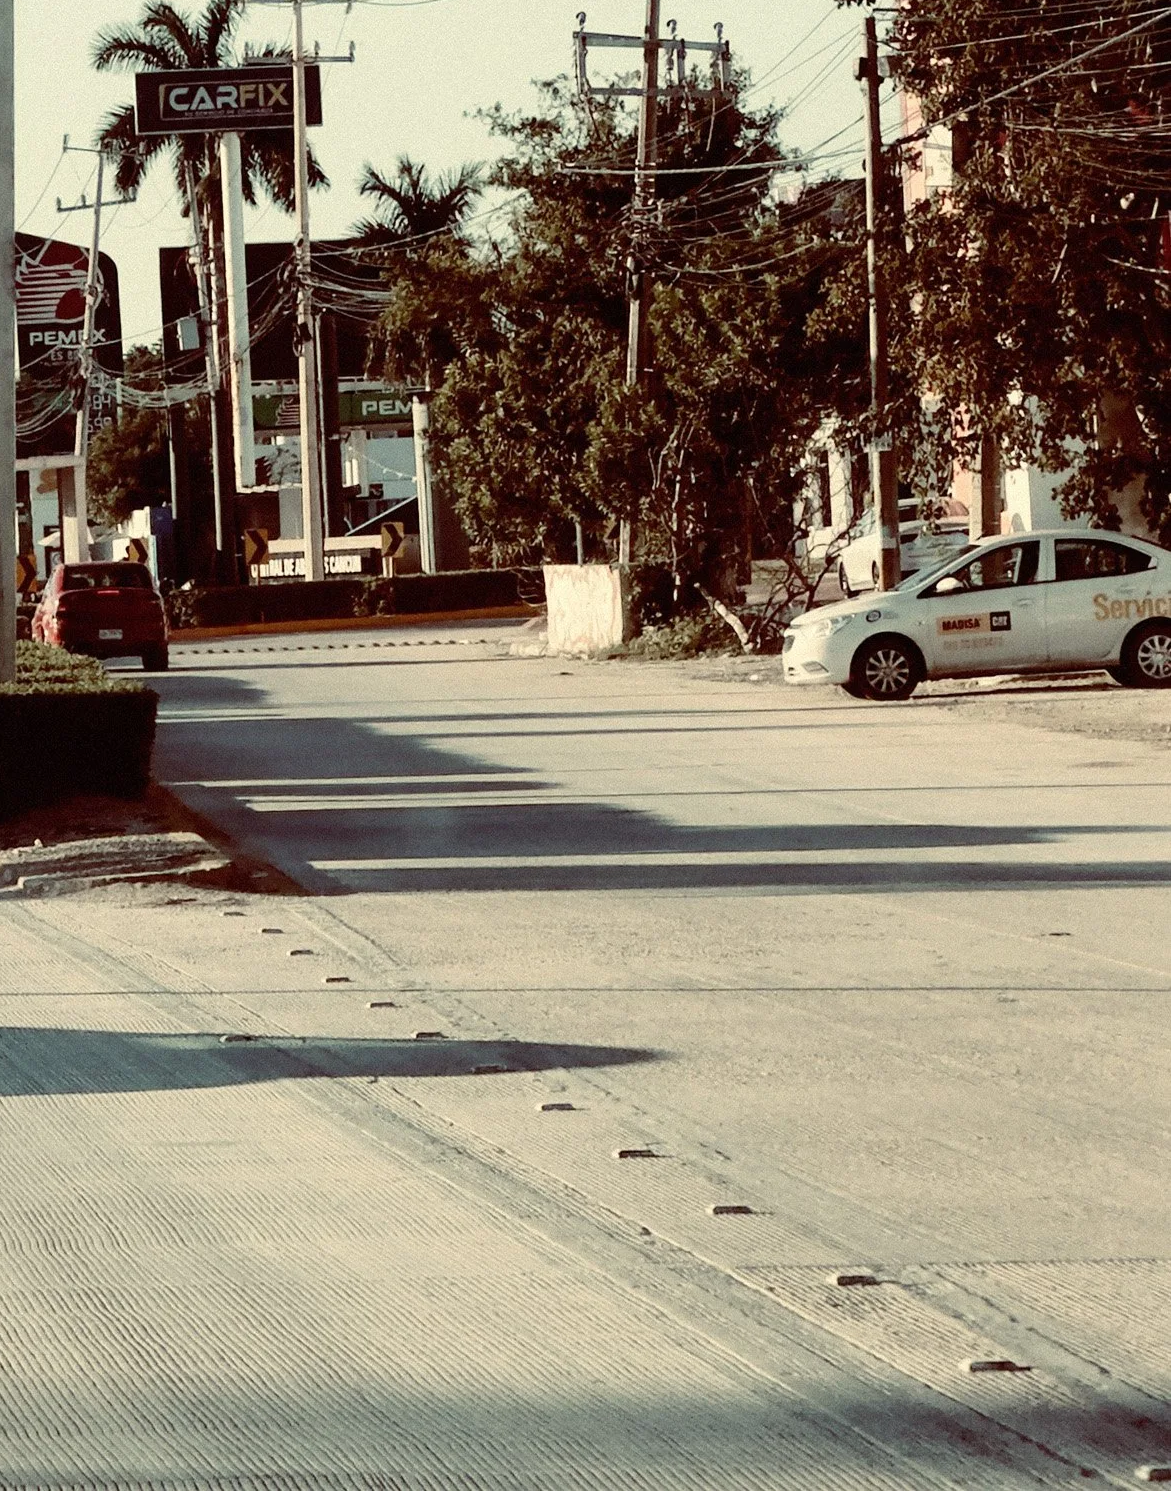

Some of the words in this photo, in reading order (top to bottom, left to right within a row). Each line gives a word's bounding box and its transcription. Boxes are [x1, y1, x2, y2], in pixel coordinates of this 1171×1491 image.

[169, 82, 289, 111] CARFIX
[361, 399, 412, 416] PEM
[942, 618, 981, 631] MADISA
